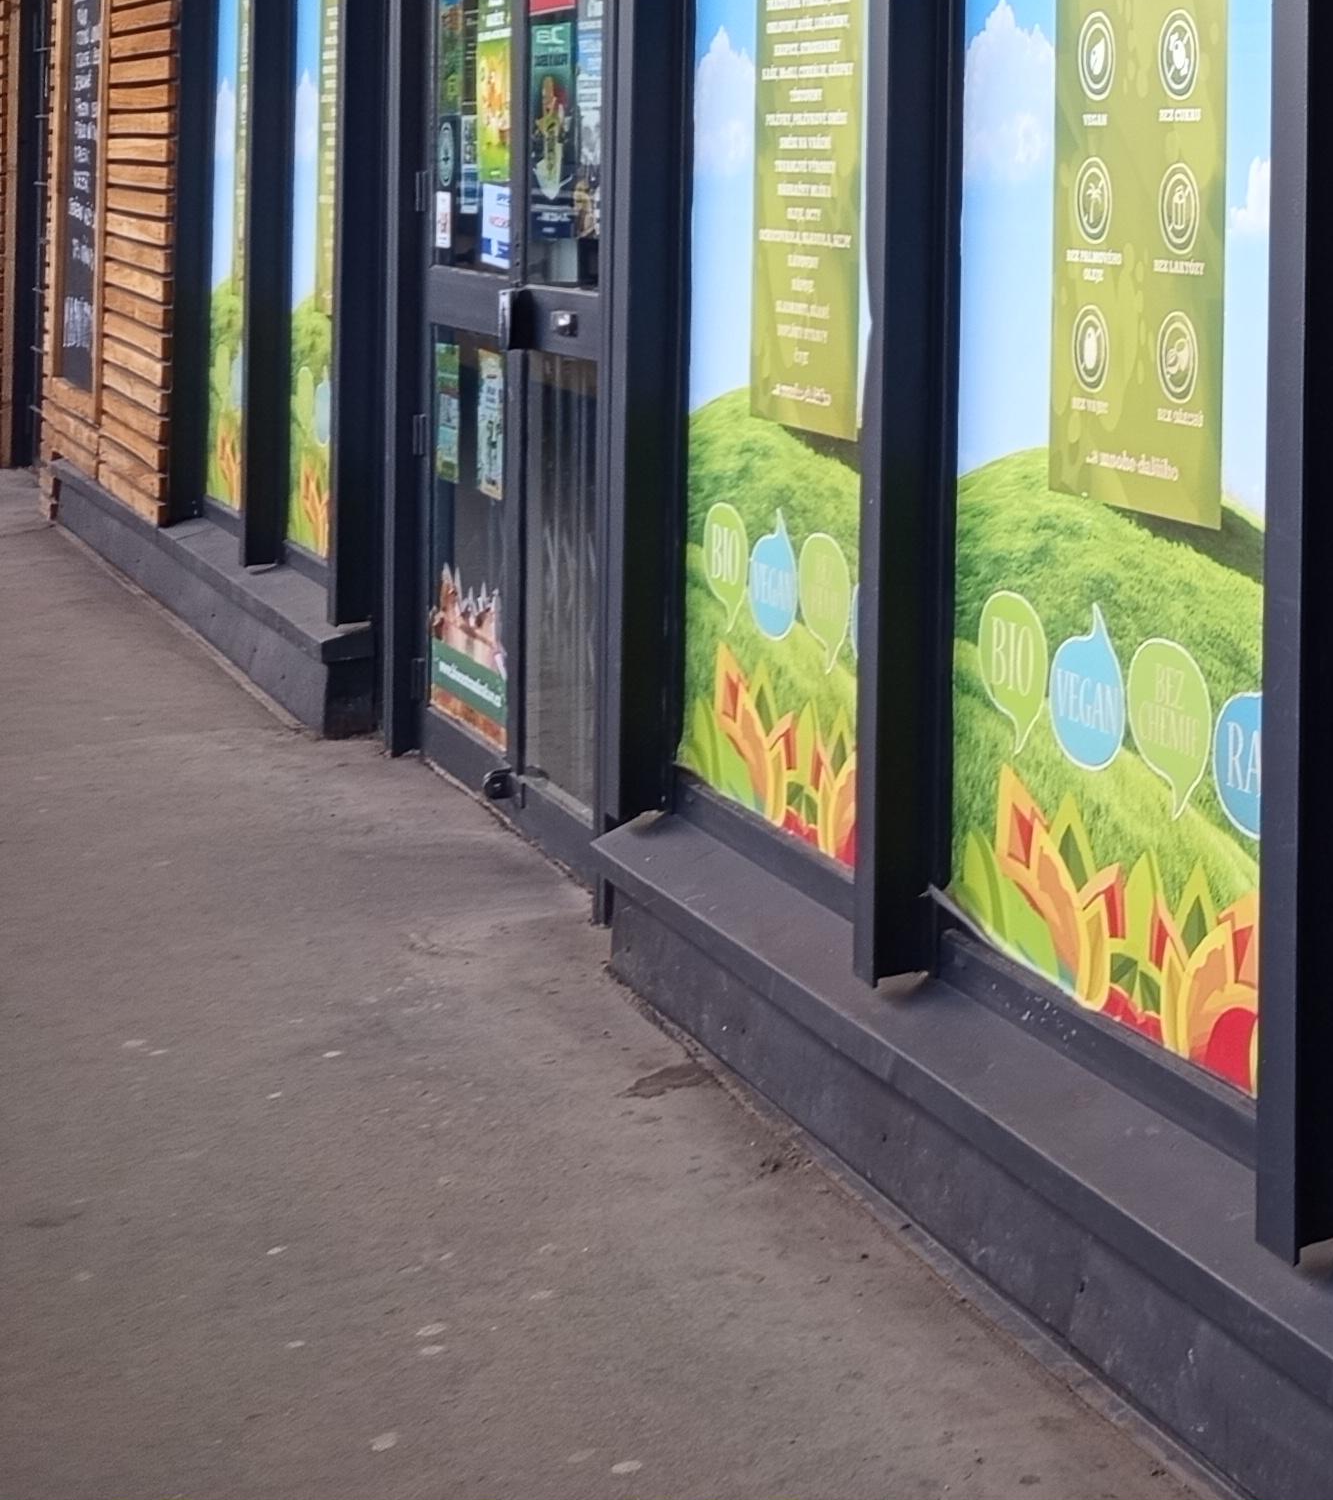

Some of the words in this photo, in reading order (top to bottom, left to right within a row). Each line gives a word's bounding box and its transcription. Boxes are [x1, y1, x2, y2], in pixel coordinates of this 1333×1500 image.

[711, 523, 740, 586] BIO
[990, 617, 1034, 696] BIO
[1057, 668, 1119, 736] VEGAN
